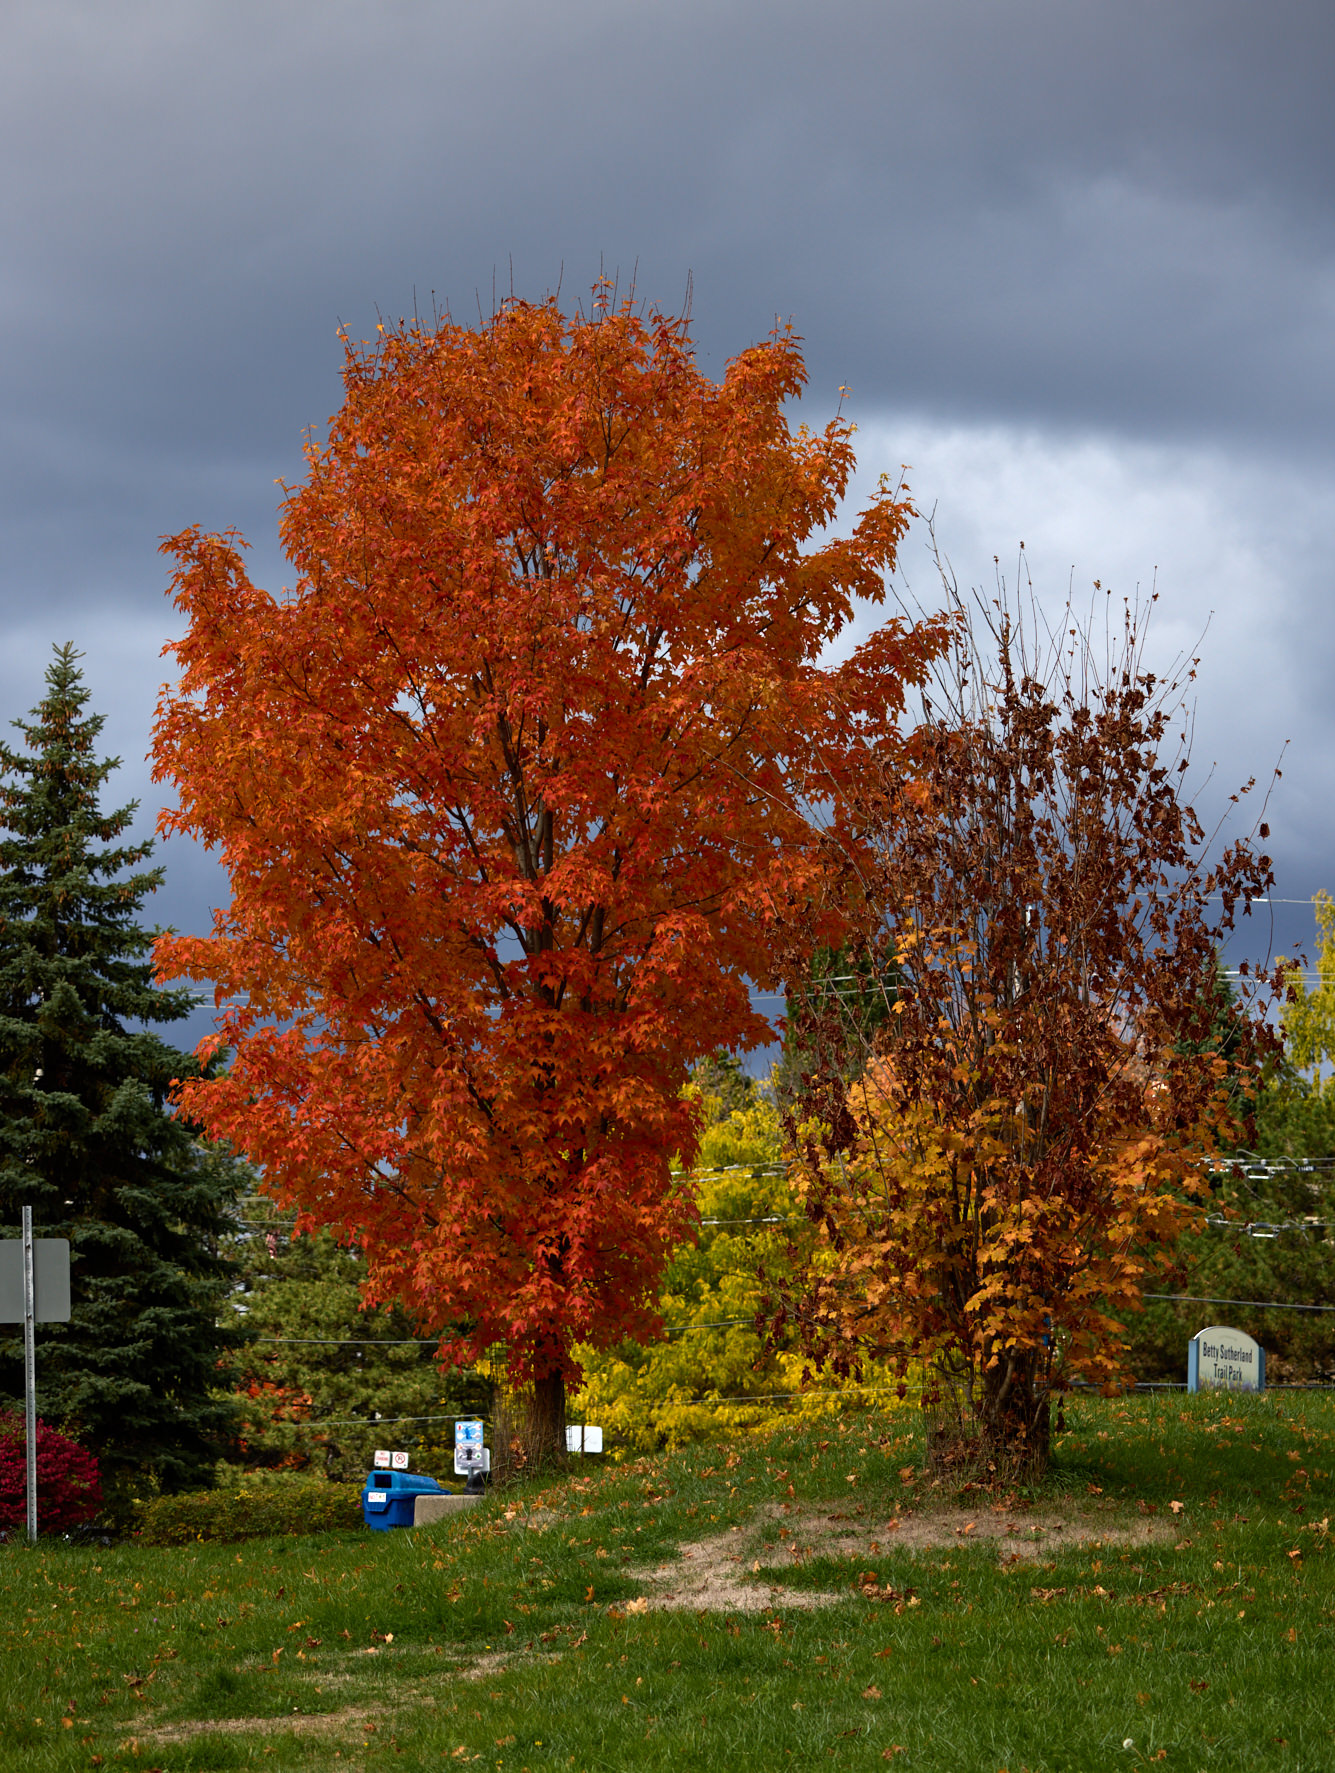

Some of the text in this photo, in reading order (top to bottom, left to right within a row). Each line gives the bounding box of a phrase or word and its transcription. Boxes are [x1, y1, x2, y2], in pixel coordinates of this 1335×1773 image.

[1203, 1342, 1252, 1363] Betty Sutherland
[1214, 1363, 1242, 1381] Trail Park
